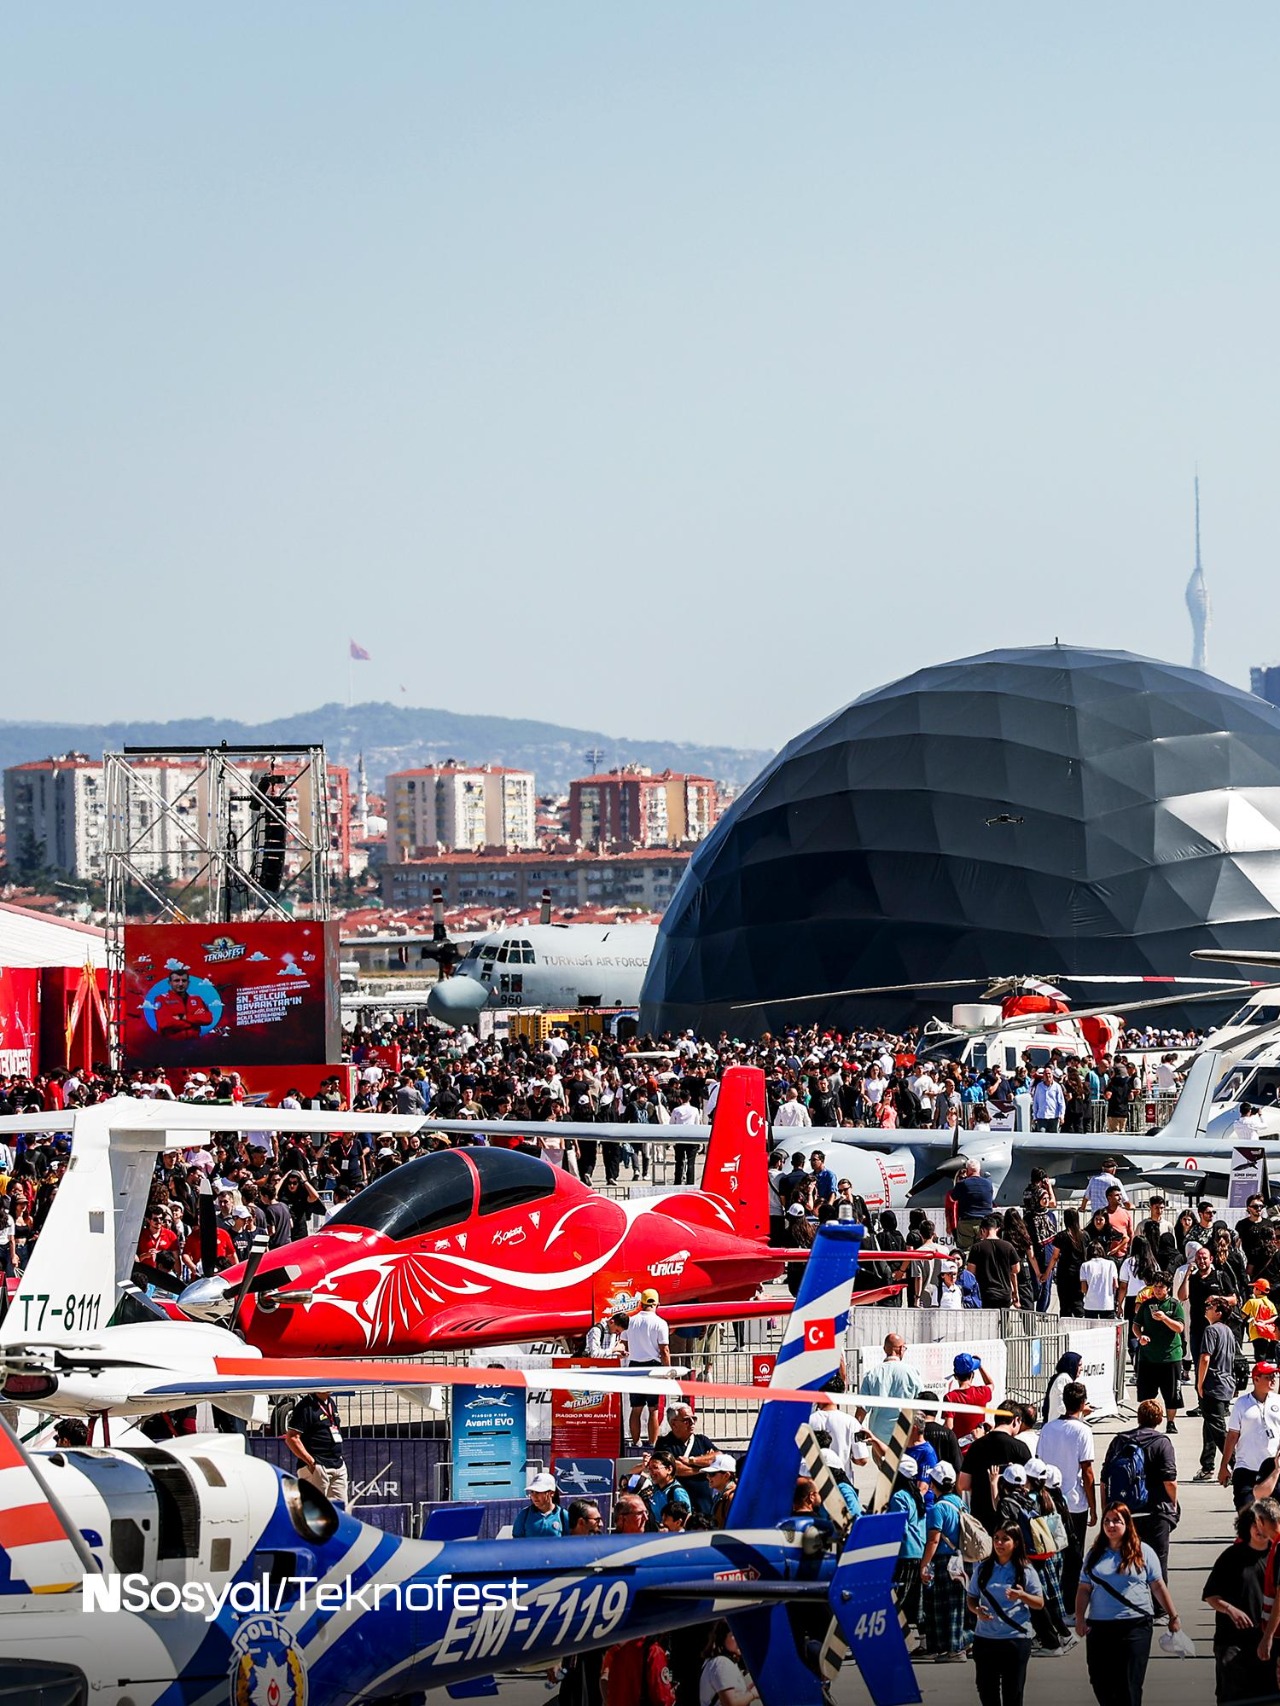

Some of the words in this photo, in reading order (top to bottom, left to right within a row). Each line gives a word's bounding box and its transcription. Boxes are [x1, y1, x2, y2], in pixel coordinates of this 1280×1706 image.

[204, 947, 246, 963] TEKNOFEST
[543, 955, 593, 967] TURKISH
[597, 956, 613, 966] AIR
[616, 956, 648, 967] FORCE
[501, 994, 523, 1005] 960
[20, 1293, 101, 1332] T7-8111
[494, 1418, 514, 1426] EVO
[346, 1481, 398, 1497] KAR
[432, 1580, 629, 1666] EM-7119
[854, 1609, 887, 1640] 415
